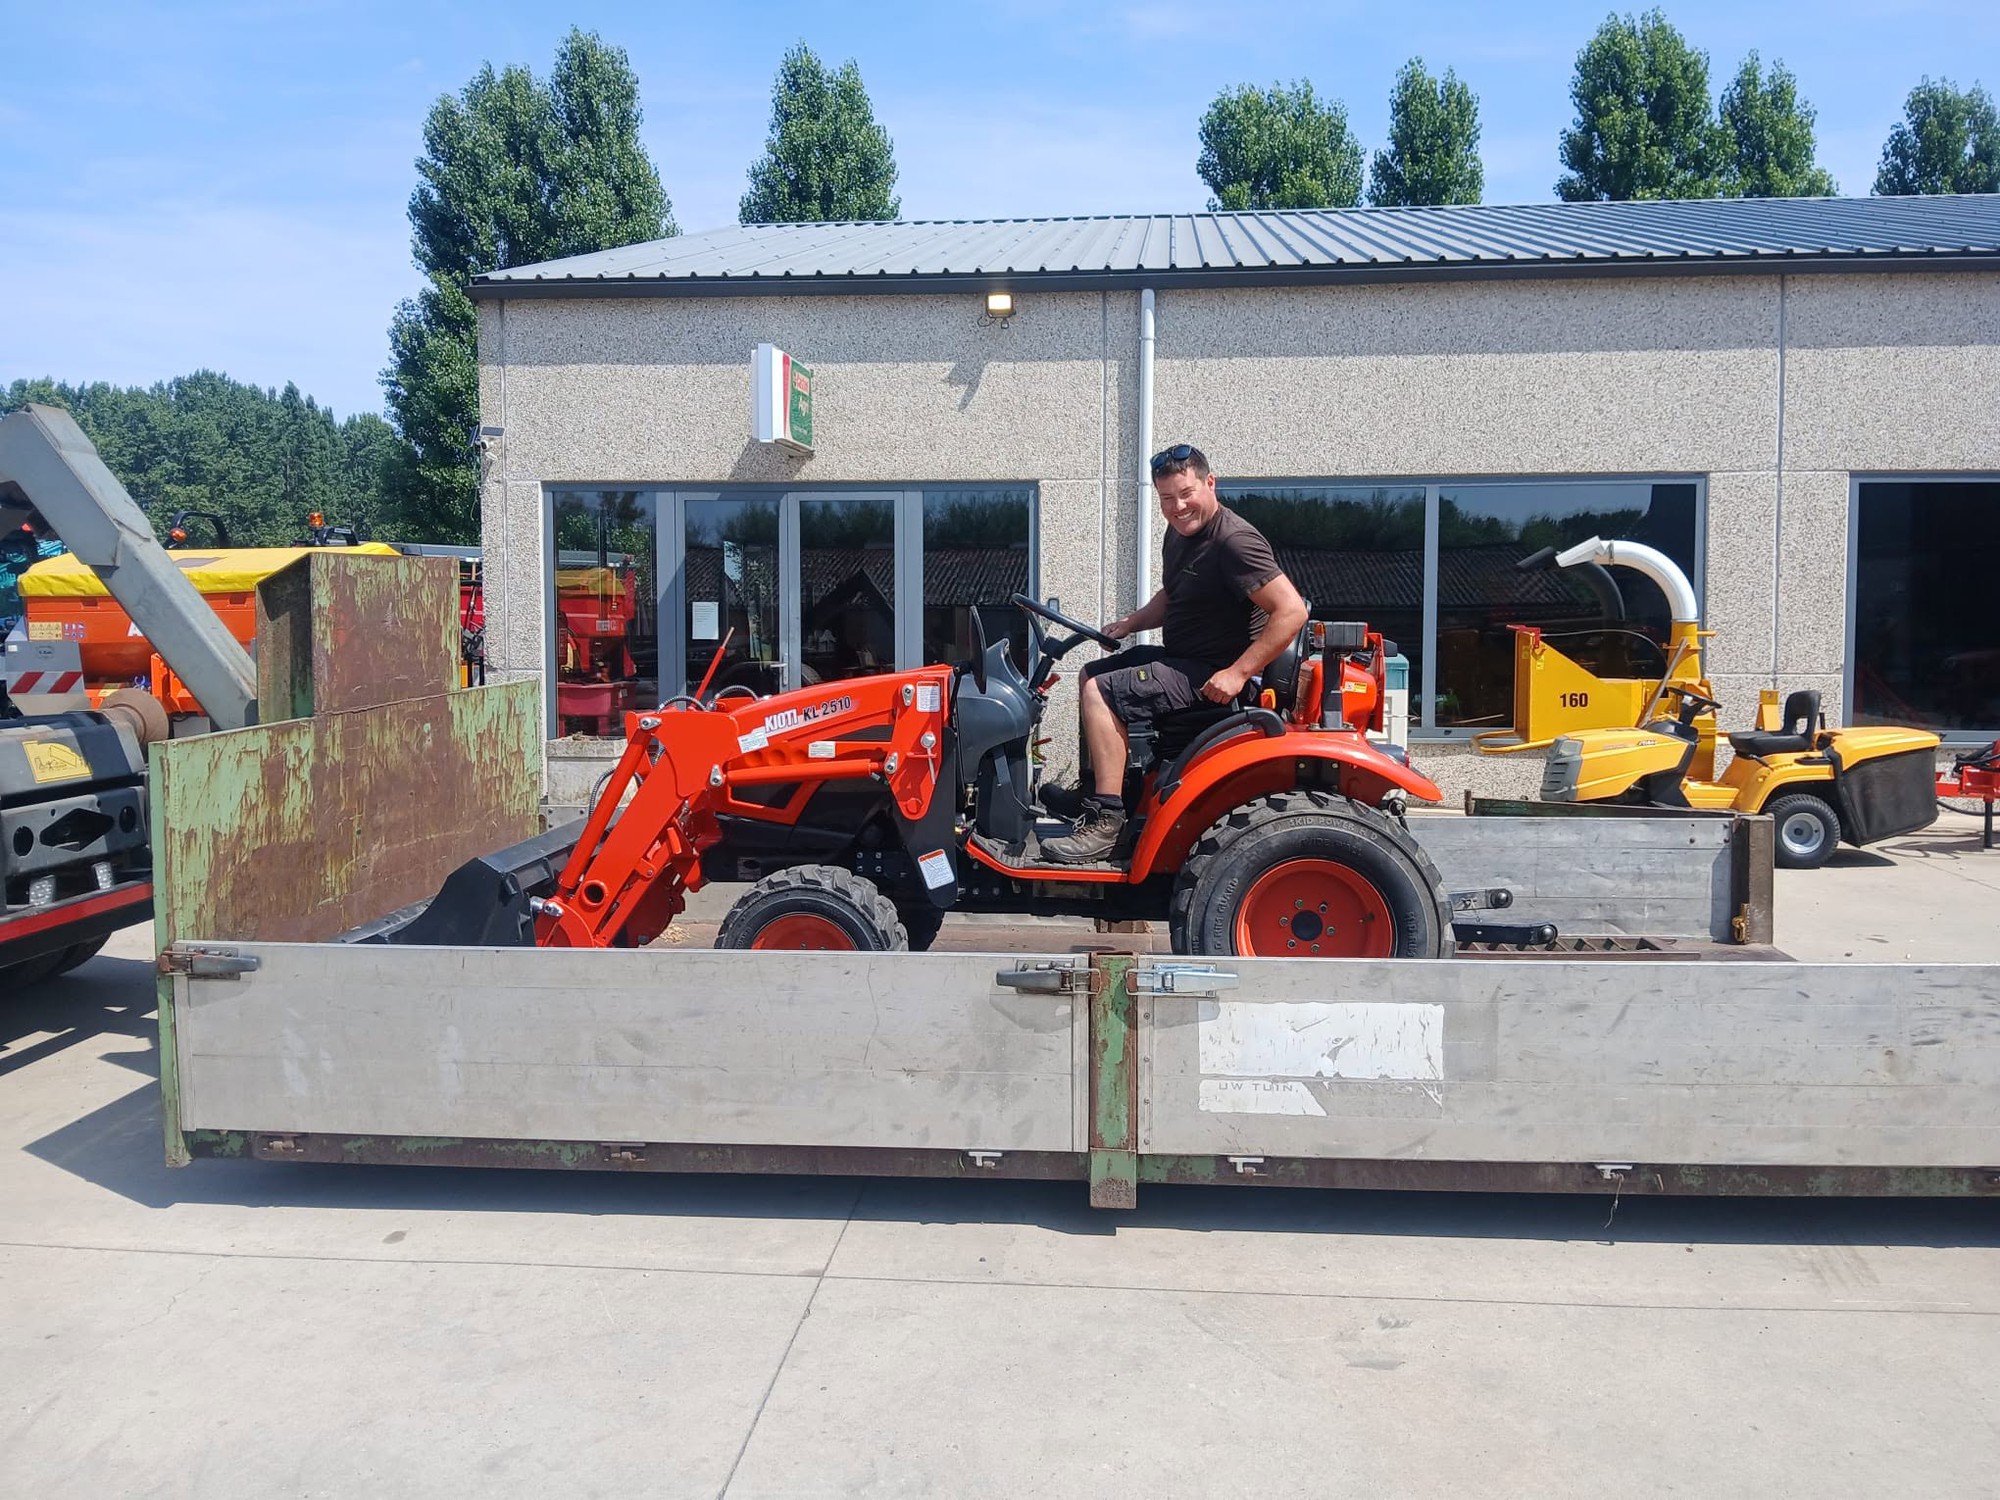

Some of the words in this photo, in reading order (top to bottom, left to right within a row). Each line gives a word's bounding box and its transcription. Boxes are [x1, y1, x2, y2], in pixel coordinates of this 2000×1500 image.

[1560, 692, 1588, 708] 160
[765, 709, 798, 733] KIOTI
[803, 706, 819, 722] KL
[821, 696, 851, 717] 2510
[1288, 816, 1313, 828] SKID
[1319, 817, 1355, 831] POWER
[1218, 1082, 1244, 1091] UW
